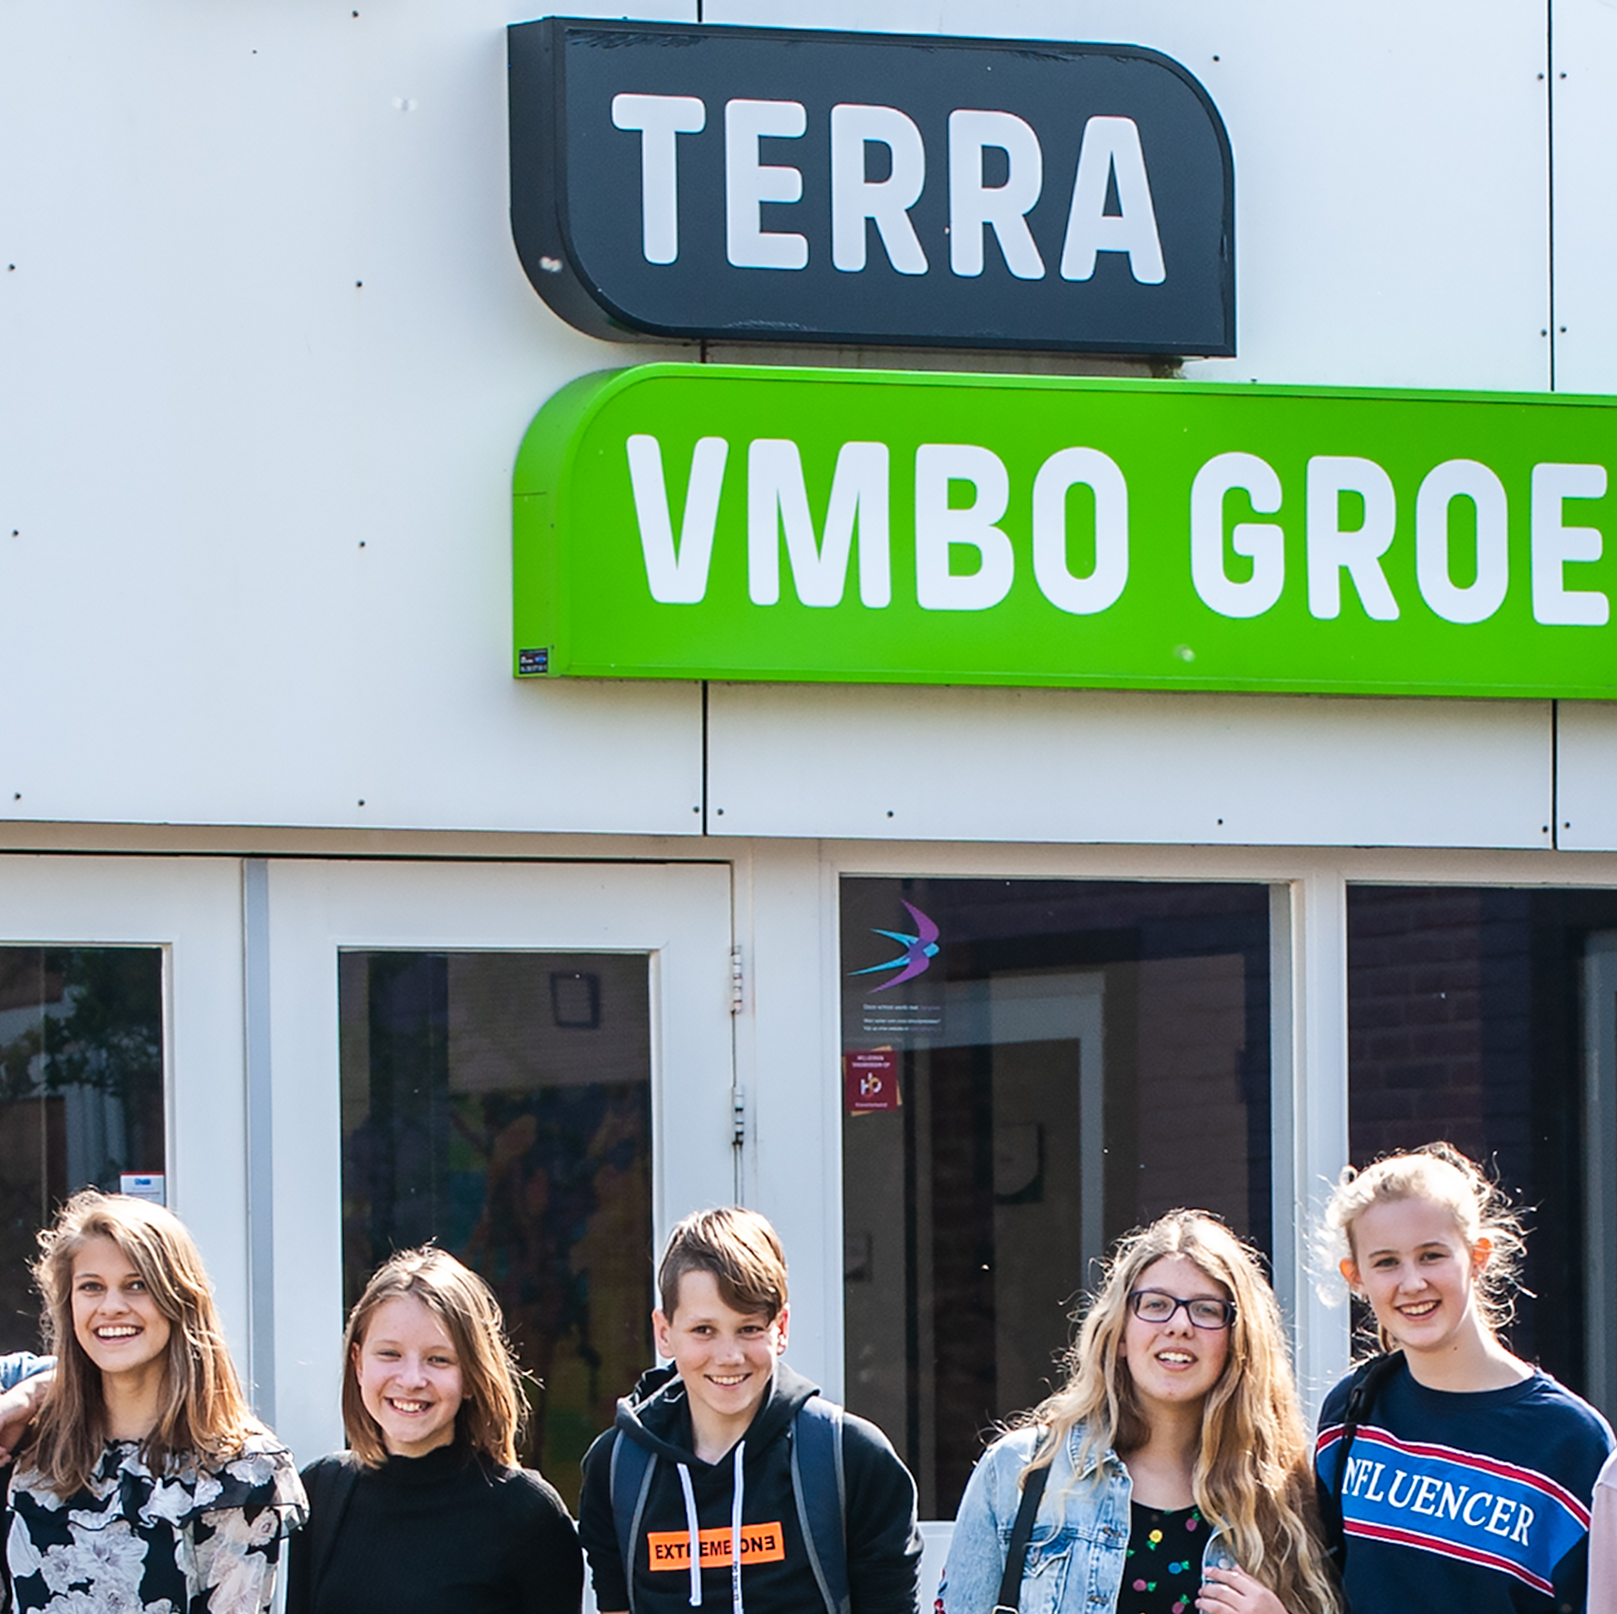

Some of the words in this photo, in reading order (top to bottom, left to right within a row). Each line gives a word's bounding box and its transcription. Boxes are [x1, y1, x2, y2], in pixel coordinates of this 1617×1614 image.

[611, 92, 1168, 286] TERRA
[626, 434, 1129, 616] VMBO
[1341, 1456, 1536, 1547] NFLUENCER
